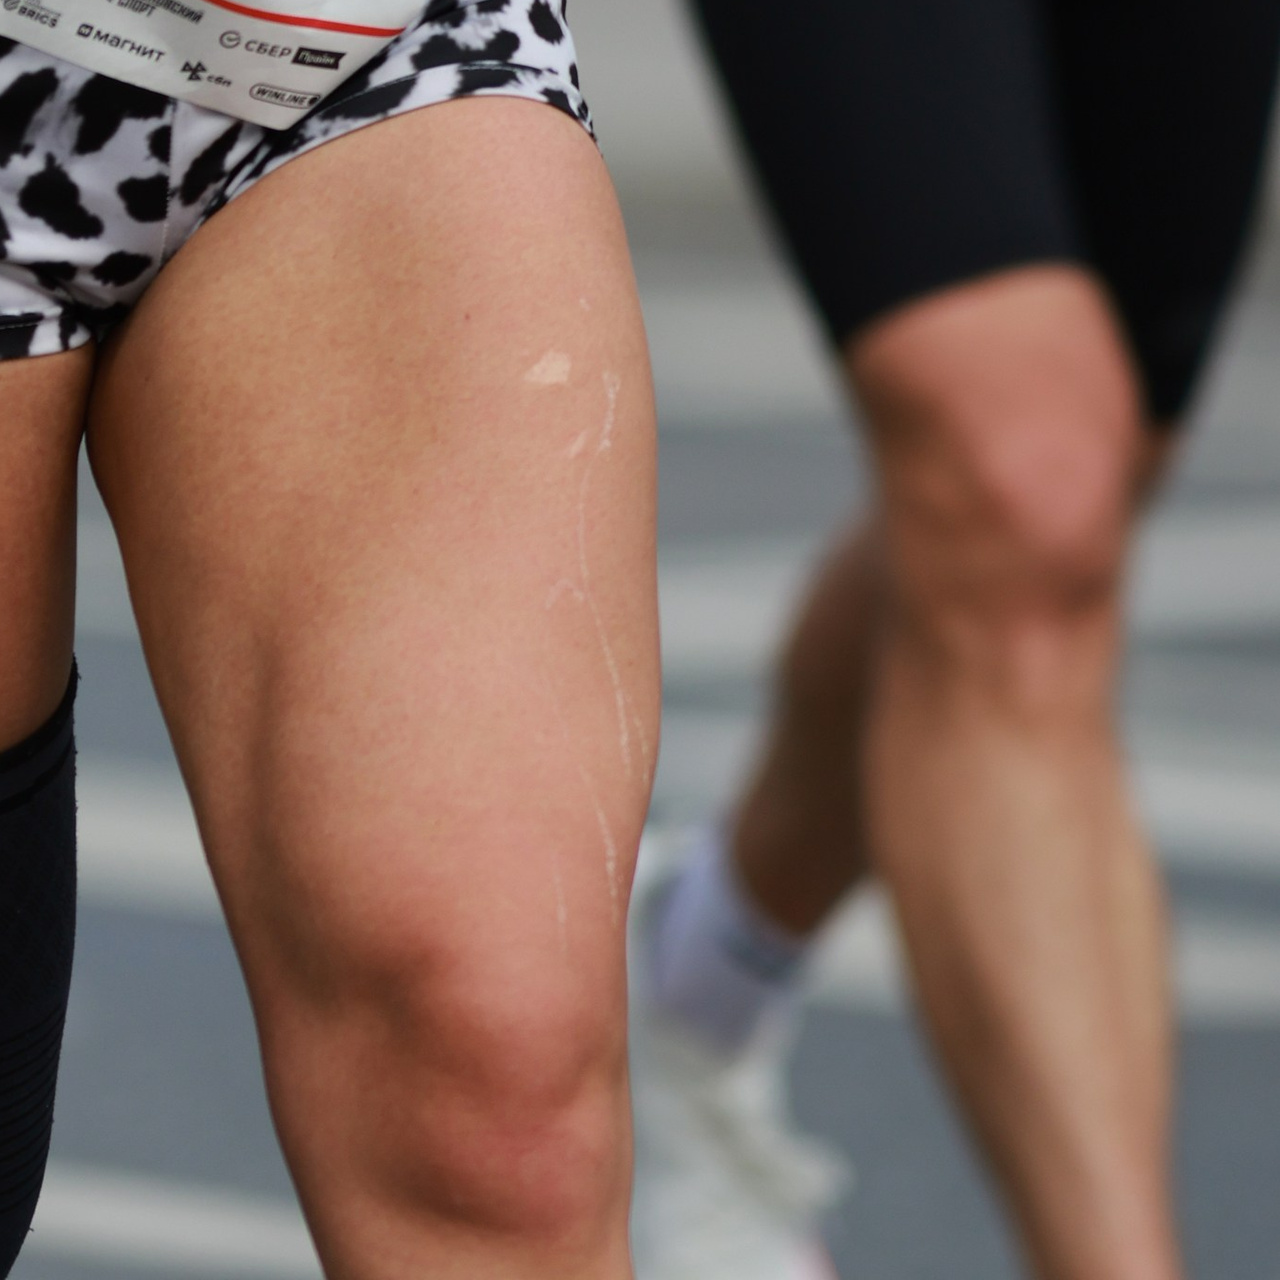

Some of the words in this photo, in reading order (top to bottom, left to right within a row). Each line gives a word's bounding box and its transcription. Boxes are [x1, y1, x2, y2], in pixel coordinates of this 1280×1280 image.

[18, 4, 59, 29] BRICS
[244, 39, 293, 60] СБЕР
[256, 86, 308, 107] WINLINE
